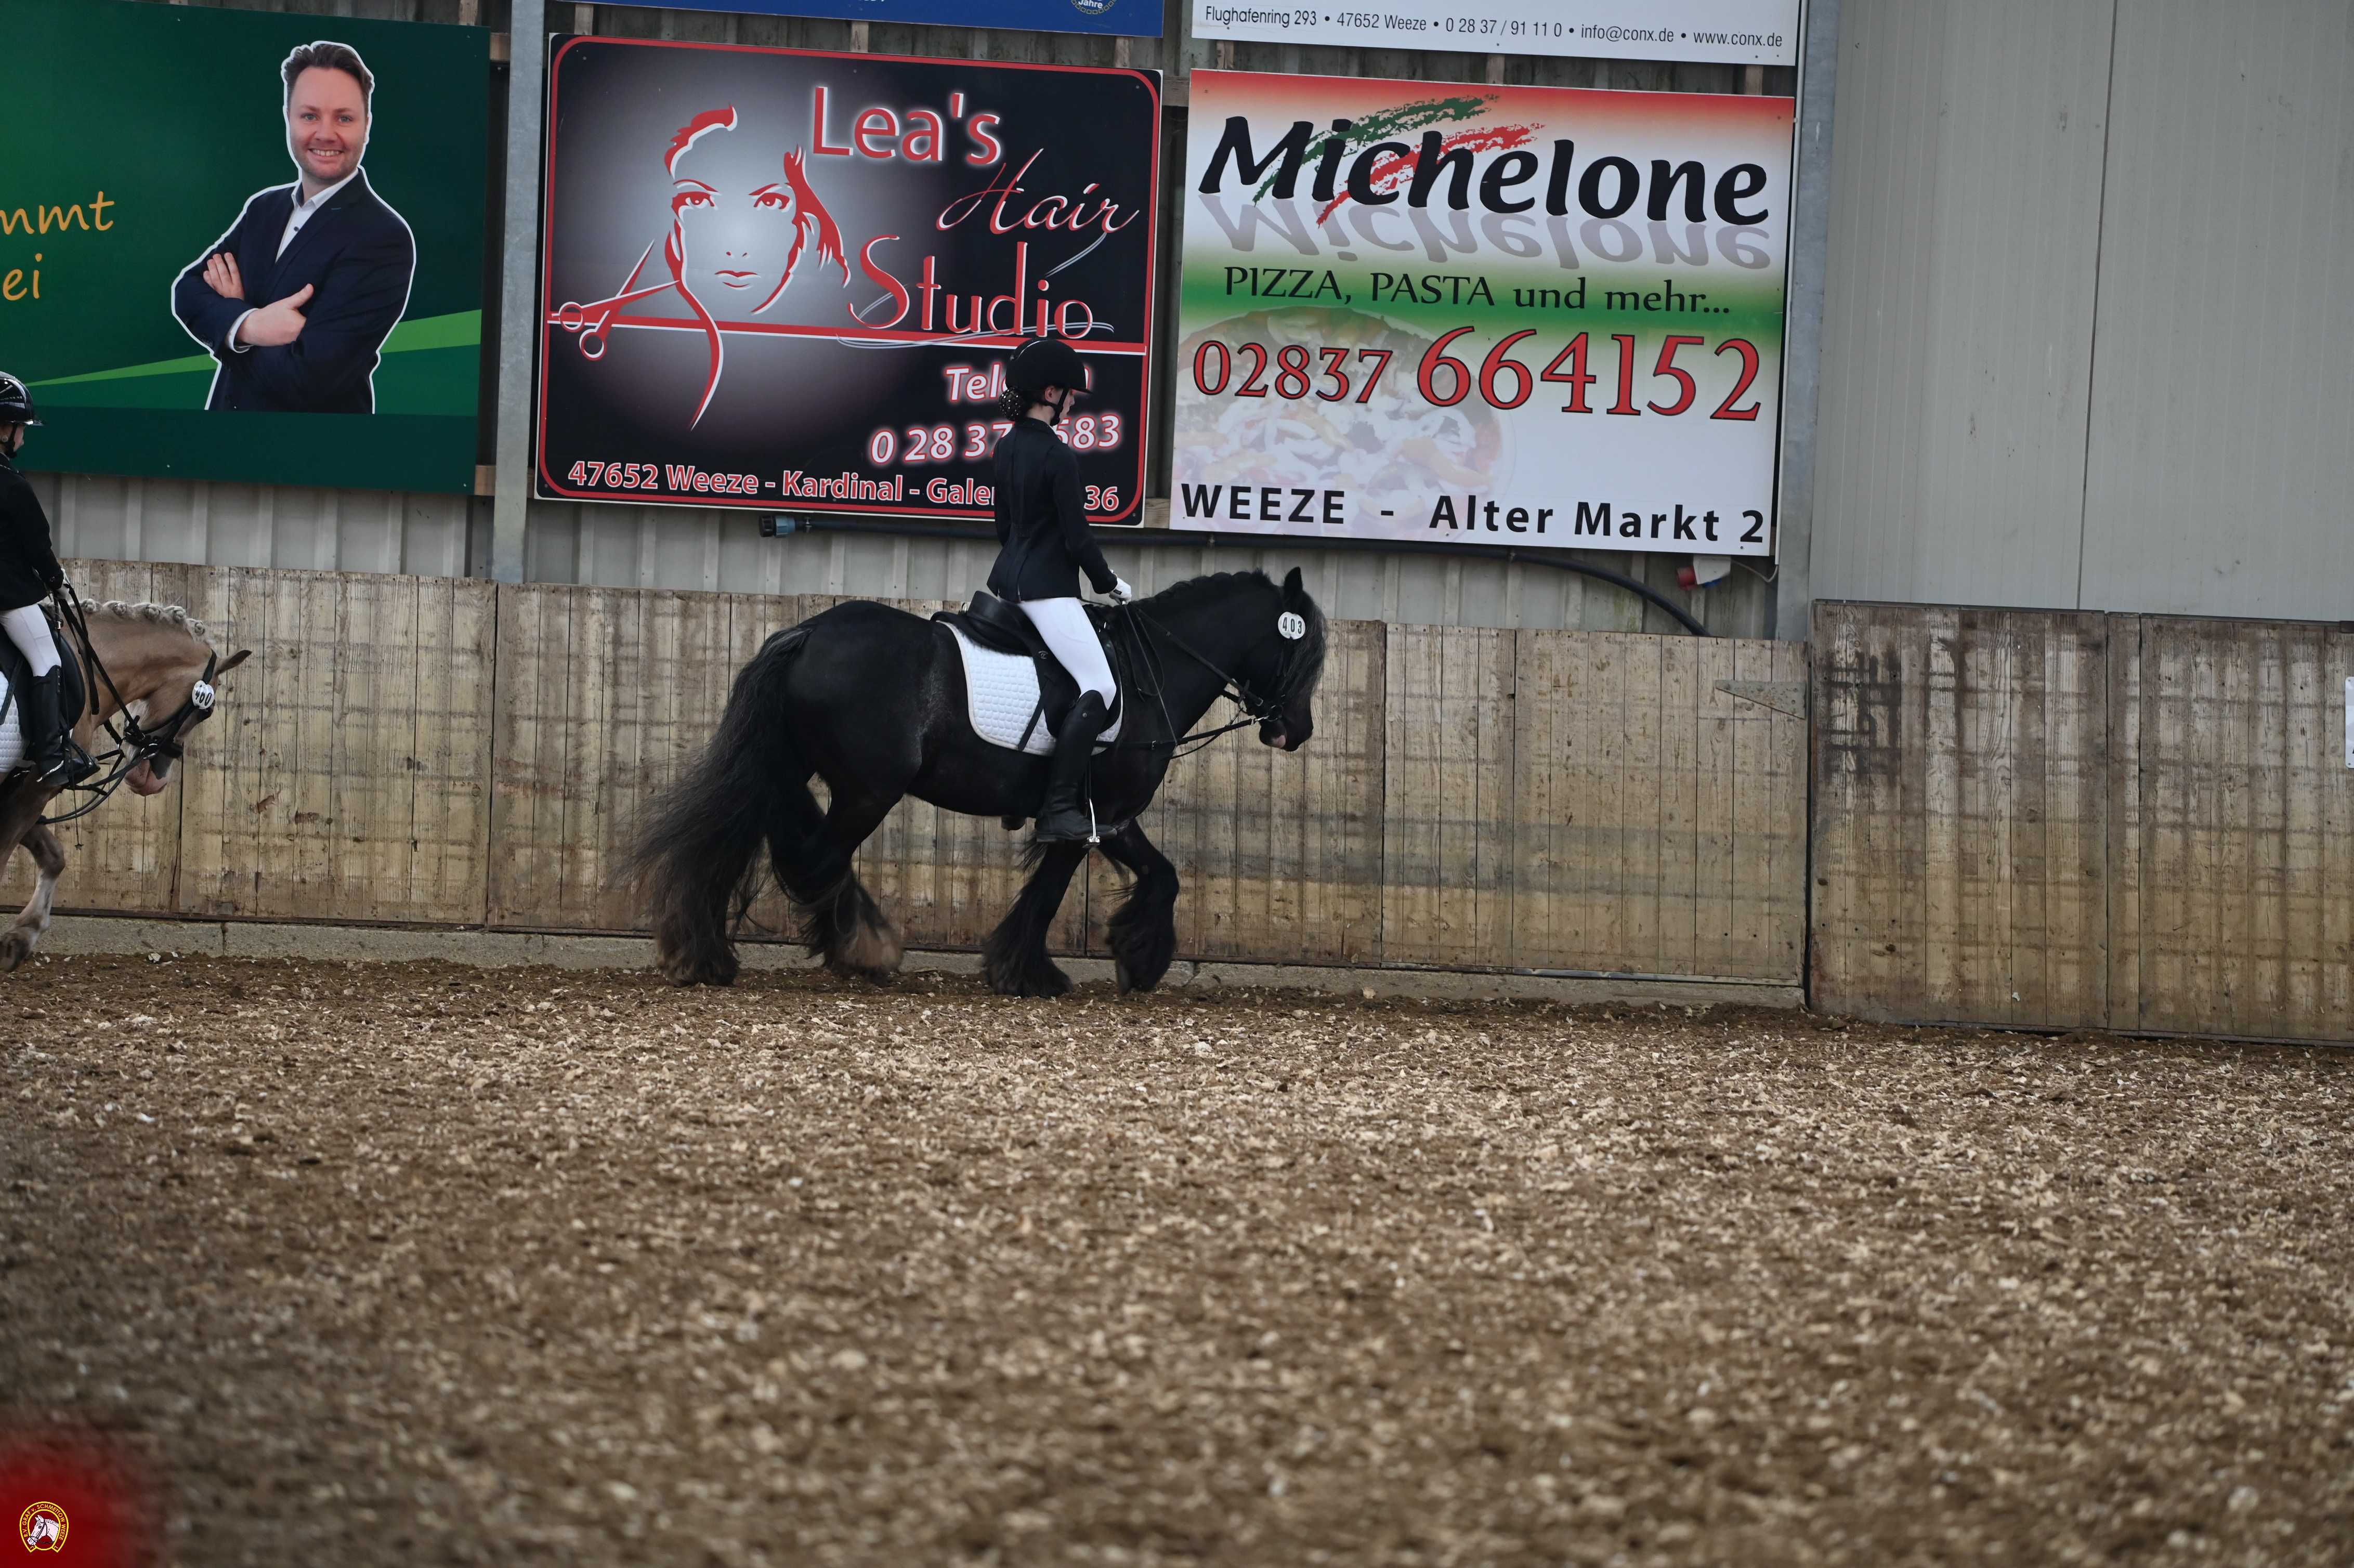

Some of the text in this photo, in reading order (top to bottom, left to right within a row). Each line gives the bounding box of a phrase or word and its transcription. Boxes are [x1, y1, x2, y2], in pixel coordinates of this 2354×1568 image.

[1078, 0, 1103, 8] Jahre
[1206, 6, 1290, 28] Flughafenring
[1294, 10, 1317, 25] 293
[1337, 12, 1379, 28] 47652
[1384, 15, 1427, 31] Weeze
[1446, 18, 1454, 32] 0
[1459, 18, 1475, 33] 28
[1480, 19, 1497, 34] 37
[1511, 21, 1525, 35] 91
[1533, 22, 1547, 36] 11
[1554, 23, 1562, 37] 0
[1581, 24, 1674, 42] info@conx.de
[1693, 32, 1783, 47] www.conx.de
[813, 86, 1001, 165] Lea's
[936, 148, 1140, 234] Hair
[1198, 115, 1769, 226] Michelone
[848, 234, 1093, 339] Studio
[1224, 266, 1730, 314] PIZZA, PASTA und mehr...
[1193, 325, 1761, 421] 02837 664152
[871, 414, 1121, 464] 0 28 37 683
[568, 461, 658, 489] 47652
[665, 464, 758, 494] Weeze
[782, 470, 903, 501] Kardinal
[926, 477, 995, 505] Gale
[1084, 485, 1119, 511] 36
[1181, 484, 1344, 524] WEEZE
[1429, 495, 1553, 533] Alter
[1575, 502, 1719, 542] Markt
[1740, 510, 1763, 543] 2
[1283, 617, 1302, 634] 403
